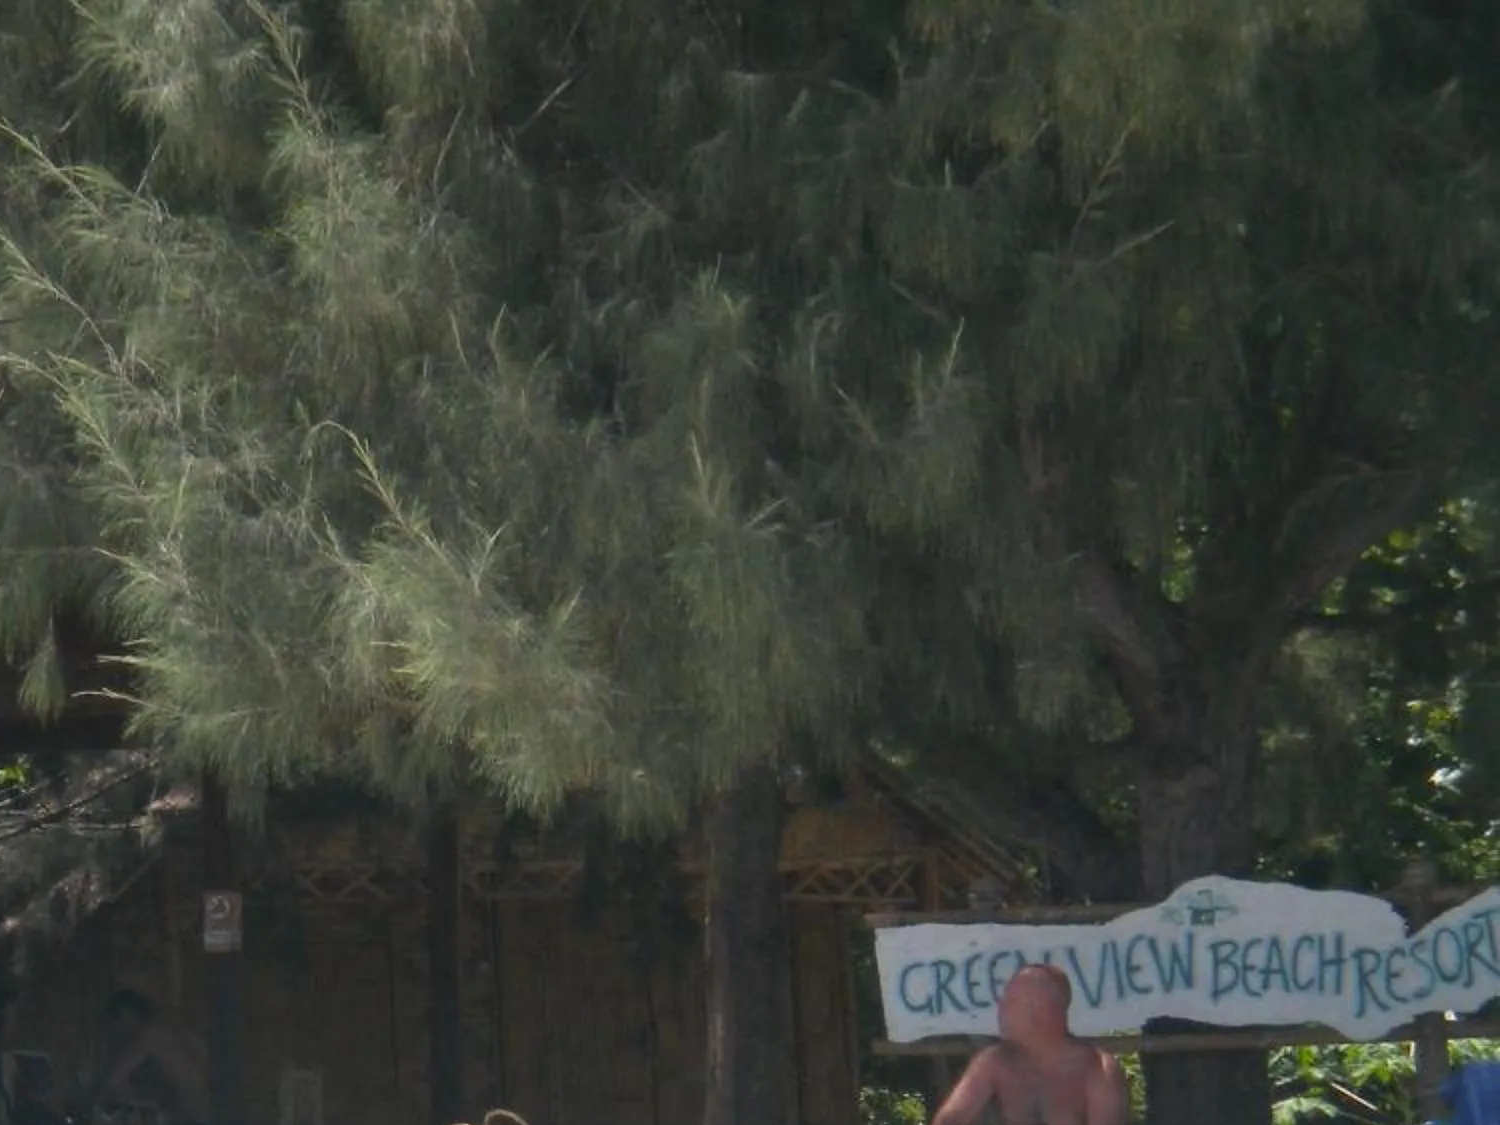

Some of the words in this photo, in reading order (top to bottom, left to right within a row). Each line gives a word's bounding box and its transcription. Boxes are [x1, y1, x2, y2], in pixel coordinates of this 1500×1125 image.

[1068, 930, 1195, 1009] VIEW
[1208, 931, 1350, 1004] BEACH
[1350, 907, 1500, 1018] RESORT
